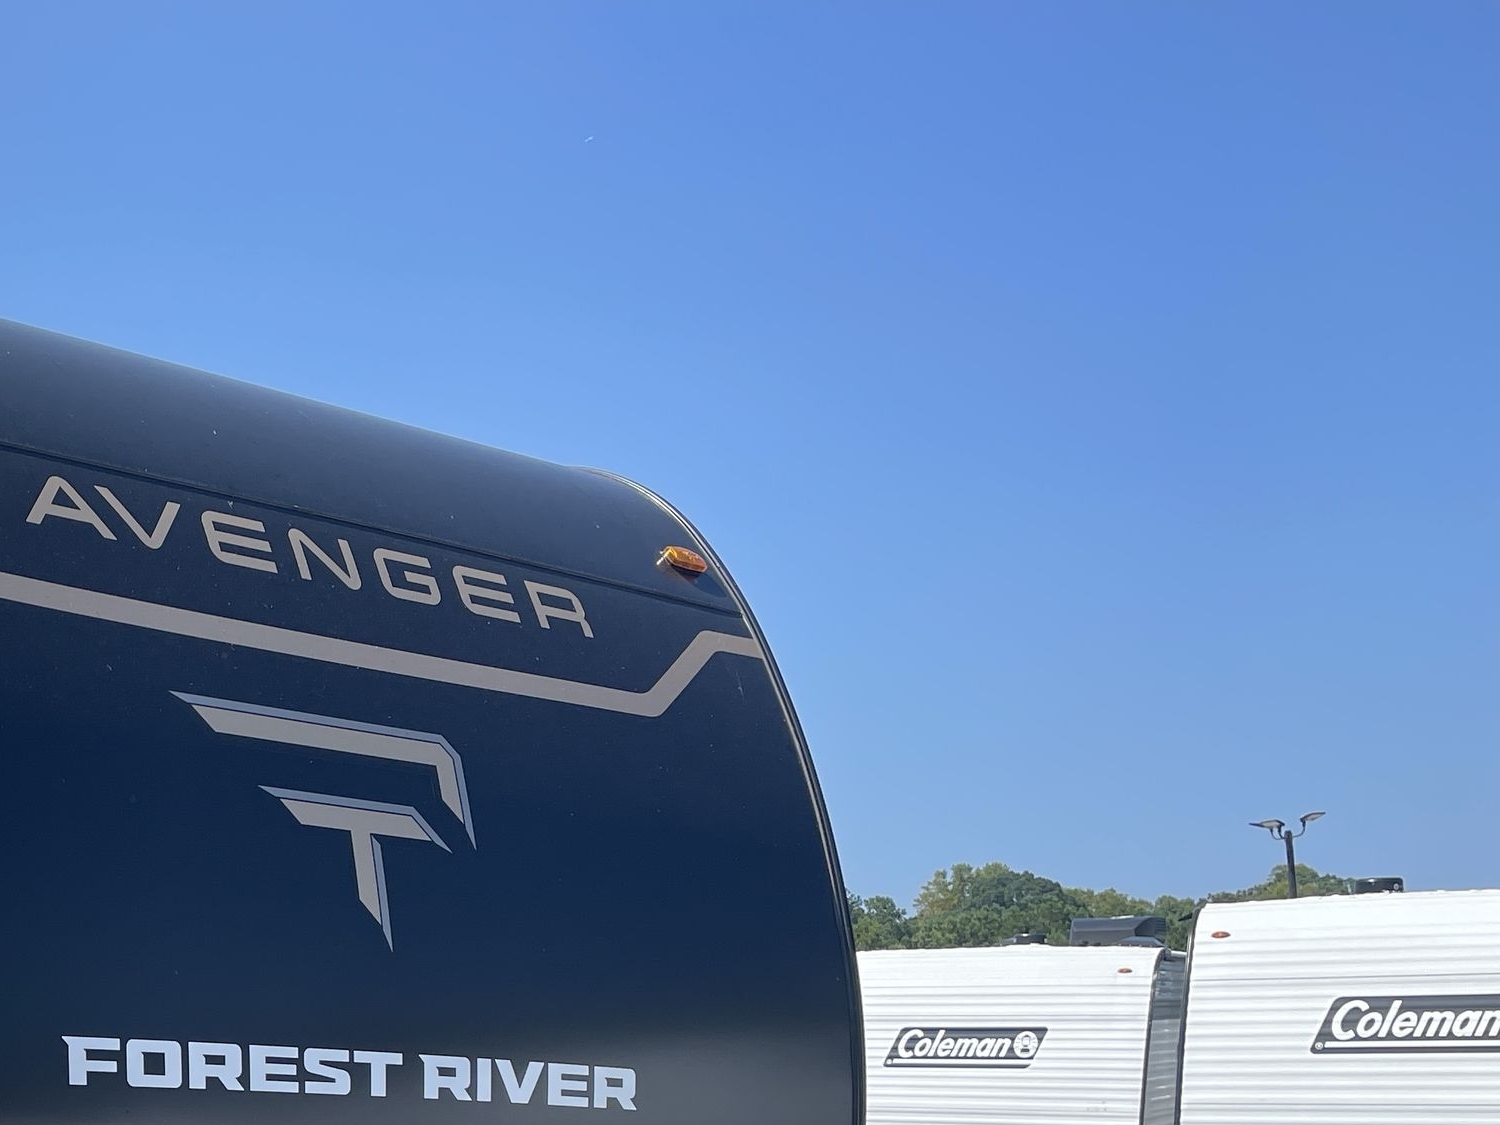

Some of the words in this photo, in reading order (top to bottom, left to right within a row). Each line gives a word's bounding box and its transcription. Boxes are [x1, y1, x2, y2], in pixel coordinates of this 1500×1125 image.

[25, 475, 595, 639] AVENGER
[897, 1028, 1012, 1059] Coleman
[1331, 999, 1500, 1041] Coleman
[61, 1035, 403, 1098] FOREST
[418, 1054, 637, 1111] RIVER
